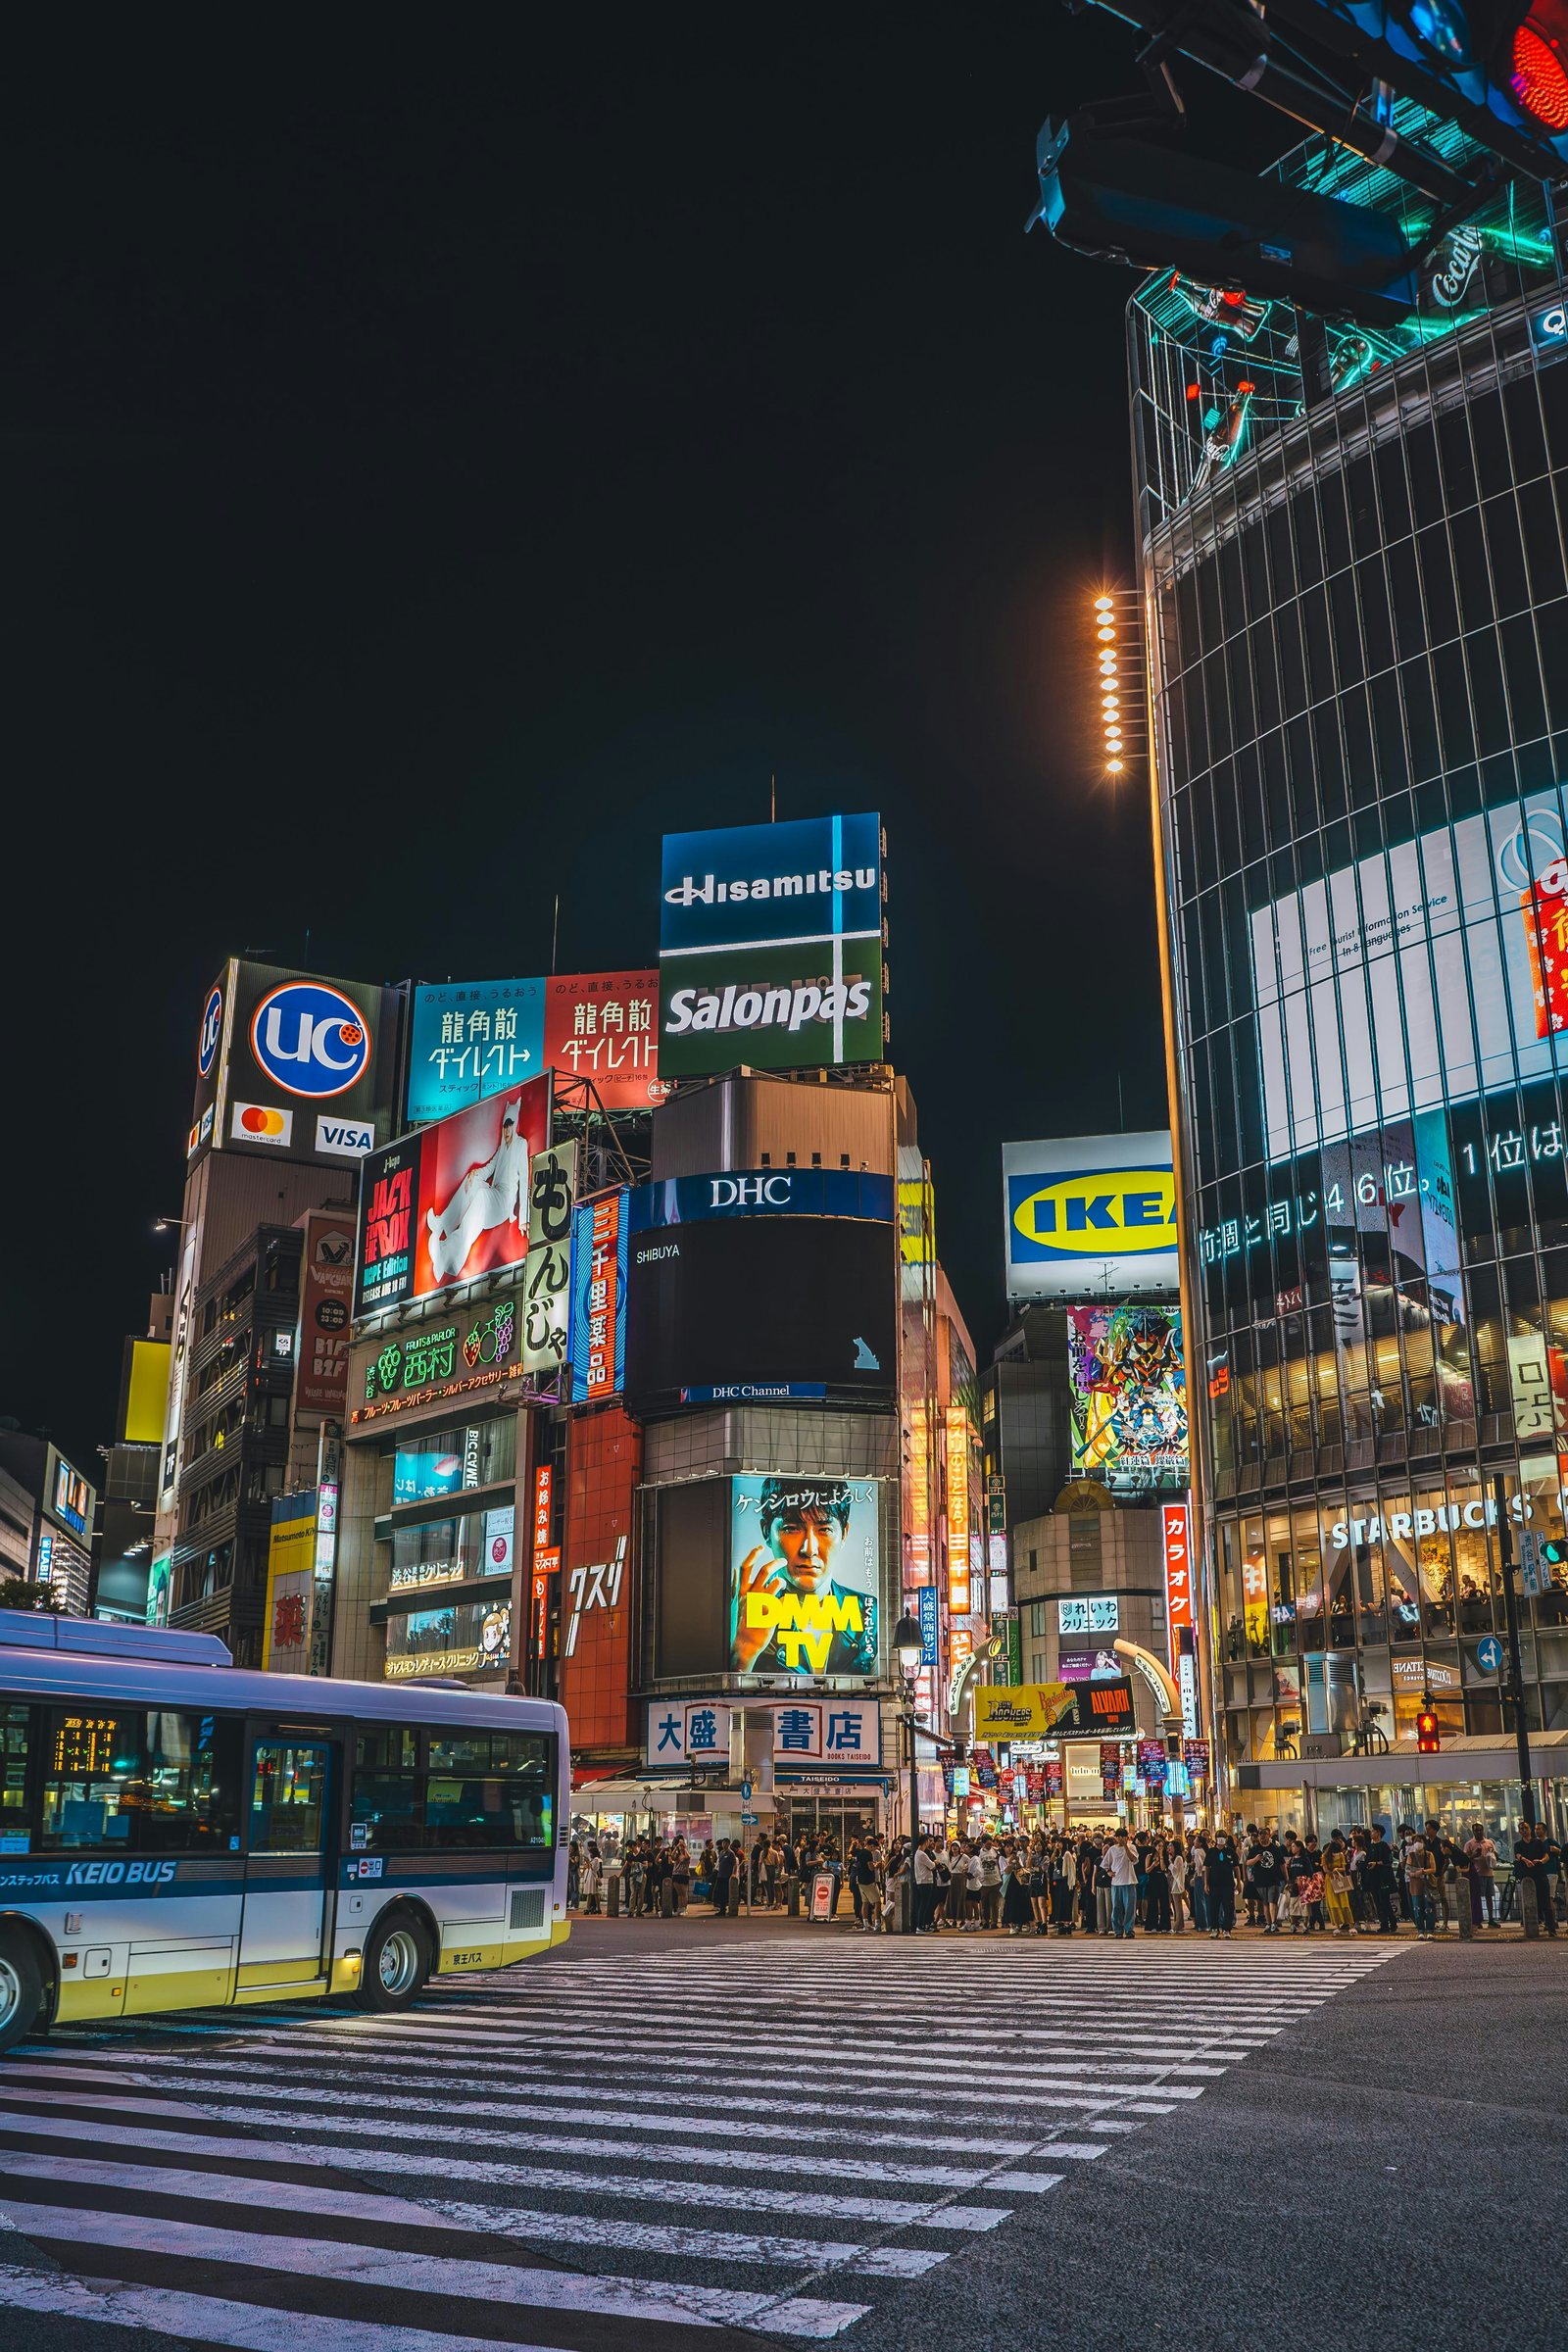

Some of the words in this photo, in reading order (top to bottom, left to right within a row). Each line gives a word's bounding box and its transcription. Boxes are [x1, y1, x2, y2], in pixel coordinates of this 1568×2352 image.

[665, 868, 875, 906] Hisamitsu
[1308, 943, 1327, 956] Free
[1357, 908, 1409, 936] Iformaion
[1411, 895, 1447, 914] Sevice
[1363, 922, 1411, 949] anguages
[424, 987, 537, 1004] のど、直接、うるおう
[665, 982, 871, 1032] Salonpas
[442, 1006, 517, 1044] 龍角散
[574, 999, 652, 1036] 龍角散
[428, 1045, 530, 1079] ダイレクト
[561, 1036, 658, 1071] ダイレクト
[439, 1083, 478, 1094] スティック
[241, 1133, 281, 1144] mastercard
[319, 1125, 371, 1151] VISA
[368, 1167, 413, 1223] JACK
[710, 1177, 791, 1207] DHC
[1034, 1191, 1176, 1234] IKE
[377, 1207, 411, 1258] BOX
[364, 1263, 382, 1287] HOPE
[383, 1255, 409, 1280] Edition
[525, 1152, 572, 1360] もんじゃ
[637, 1244, 680, 1264] SHIBUYA
[587, 1206, 611, 1386] 三千里薬品
[406, 1327, 456, 1351] FRUITS&PARLOR
[313, 1357, 346, 1378] B2F
[366, 1366, 376, 1399] 渋谷
[404, 1343, 455, 1388] 西村
[712, 1386, 740, 1397] DHC
[741, 1385, 790, 1397] Channel
[949, 1411, 965, 1525] クスリのことなら
[735, 1486, 874, 1515] ケンシロウによろしく
[1333, 1493, 1534, 1550] STARBUCKS
[863, 1537, 874, 1592] お前はもう、
[1166, 1518, 1189, 1612] カラオケ
[1524, 1535, 1538, 1591] 渋谷駅前
[274, 1592, 305, 1647] 薬
[746, 1592, 863, 1632] DMM
[1061, 1616, 1117, 1632] クリニック
[1074, 1600, 1117, 1615] れいわ
[863, 1596, 875, 1659] ほぐれている。
[922, 1591, 935, 1662] 大盛堂商事ビル
[777, 1631, 833, 1668] TV
[658, 1709, 862, 1751] 大盛書店
[803, 1787, 852, 1795] 大盛堂書店
[66, 1861, 123, 1885] KEIO
[125, 1861, 177, 1883] BUS
[453, 1951, 482, 1965] 京王バス
